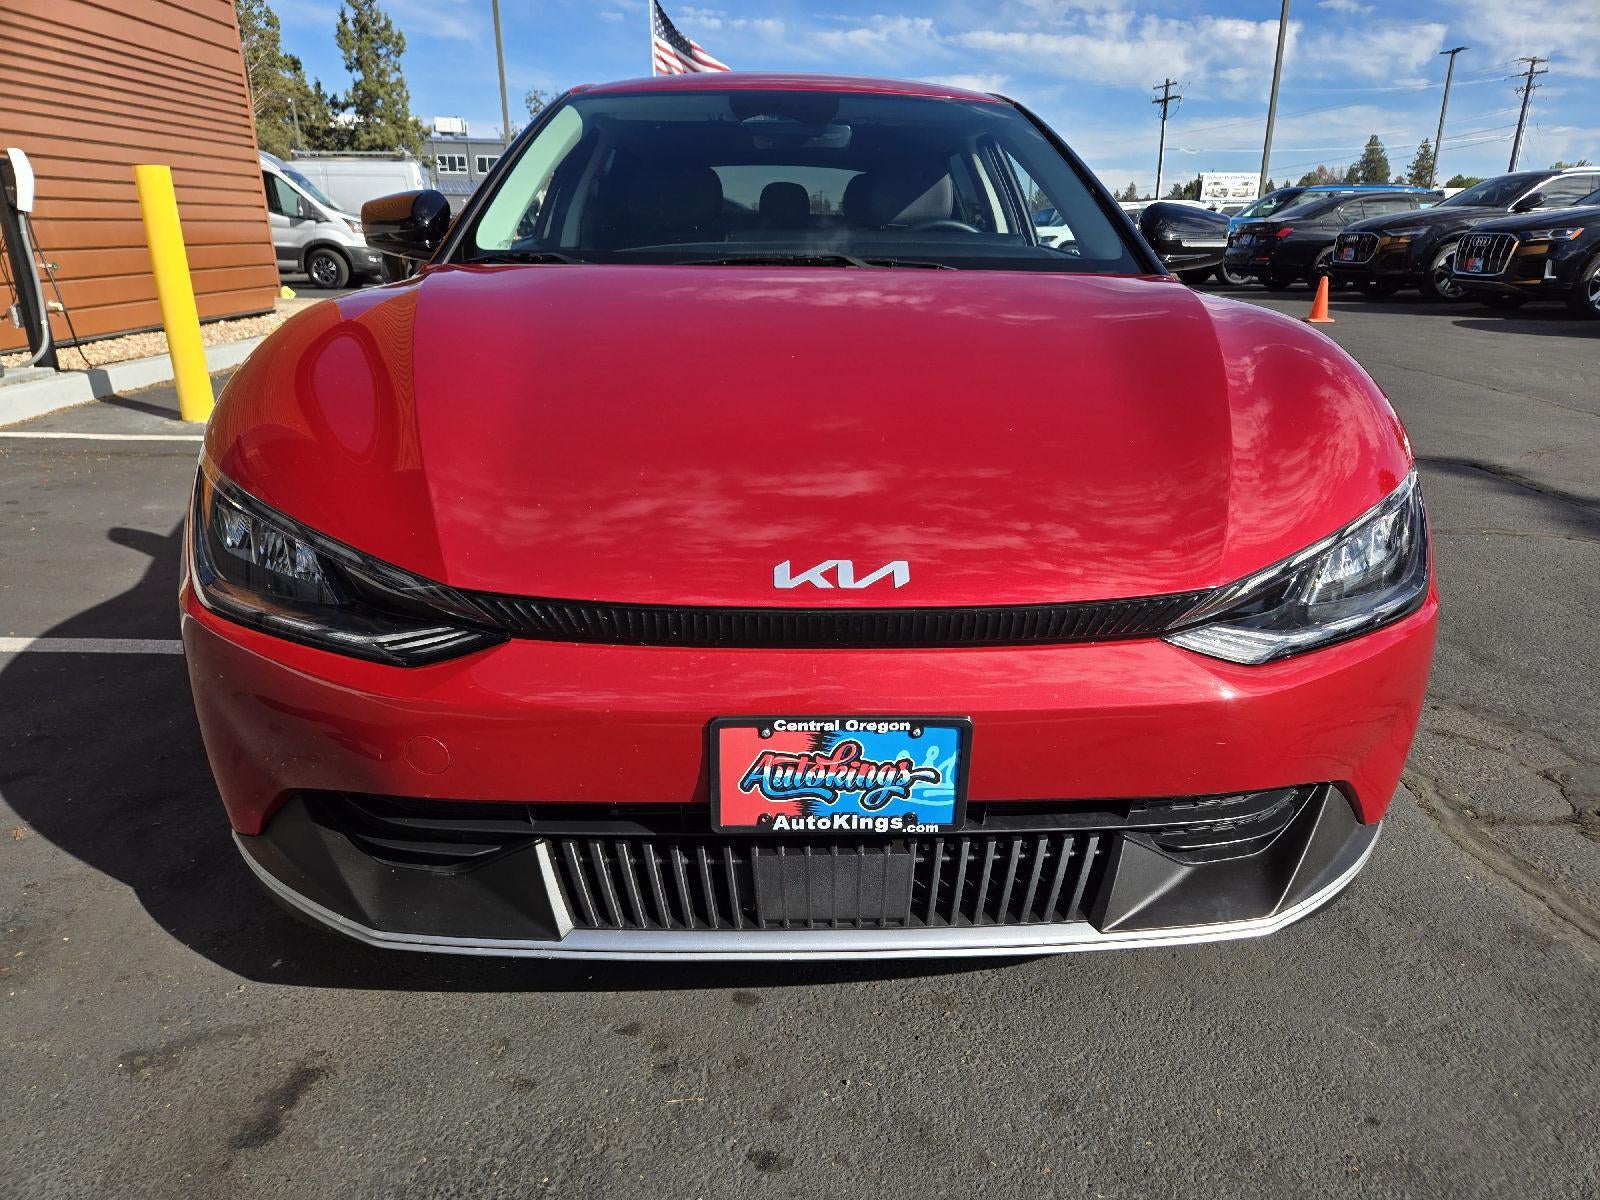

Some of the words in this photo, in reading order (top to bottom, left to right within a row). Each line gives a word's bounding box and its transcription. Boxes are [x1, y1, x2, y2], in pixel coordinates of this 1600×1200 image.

[773, 559, 910, 588] KIA
[773, 720, 839, 731] Central
[845, 720, 911, 733] Oregon
[740, 741, 940, 809] Autokings
[772, 814, 939, 833] AutoKings.com
